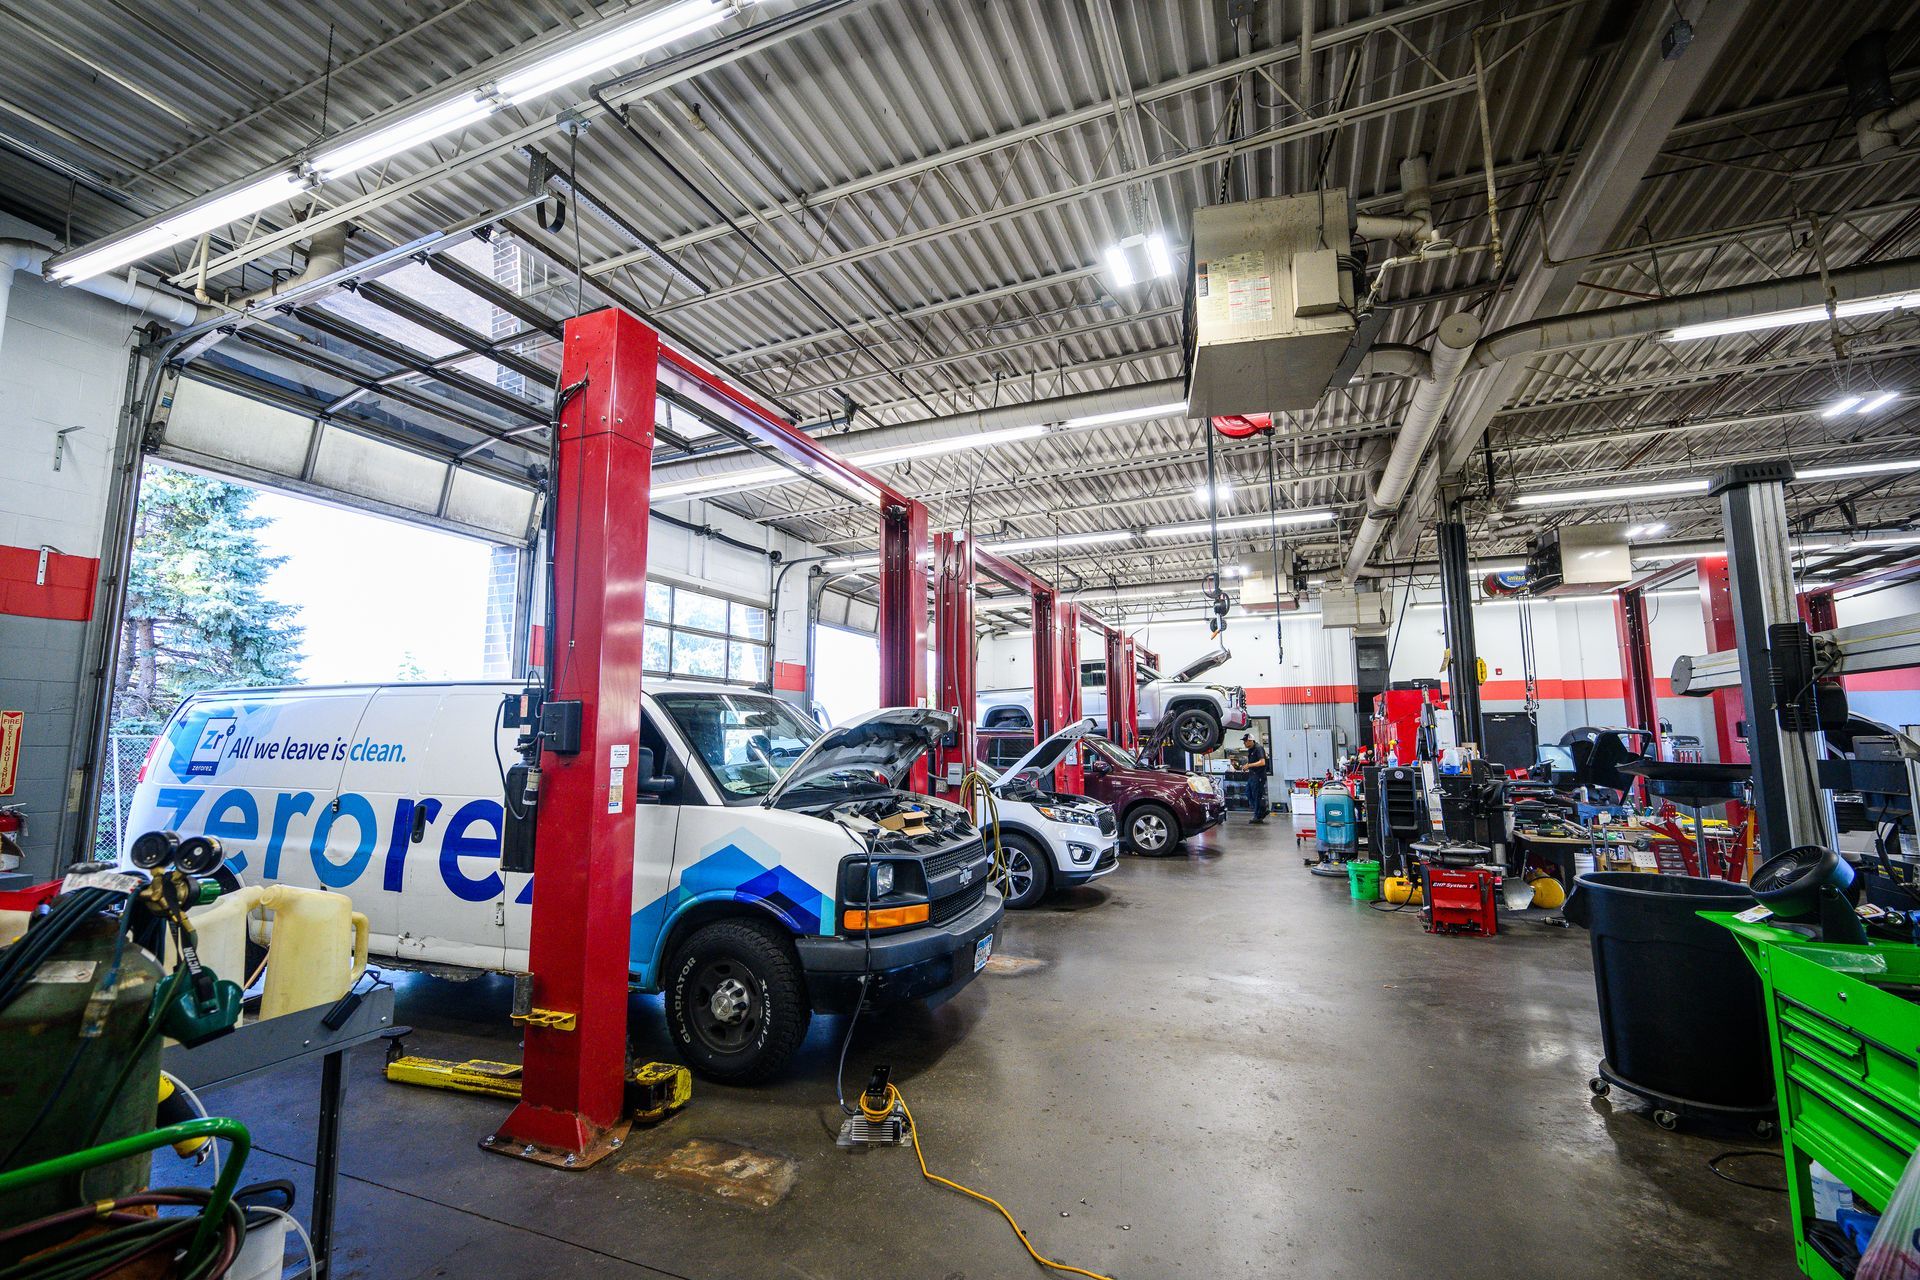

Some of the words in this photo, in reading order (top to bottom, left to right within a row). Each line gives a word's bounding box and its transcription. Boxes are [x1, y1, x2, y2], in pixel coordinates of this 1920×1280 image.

[0, 725, 13, 788] EXTINGUISHER
[228, 736, 255, 759] All
[253, 742, 279, 760] we
[281, 736, 329, 761] leave
[331, 737, 347, 761] is
[350, 737, 406, 763] clean.
[156, 788, 533, 904] zerore
[183, 947, 202, 975] VICTOR
[674, 957, 697, 1044] GLADIATOR
